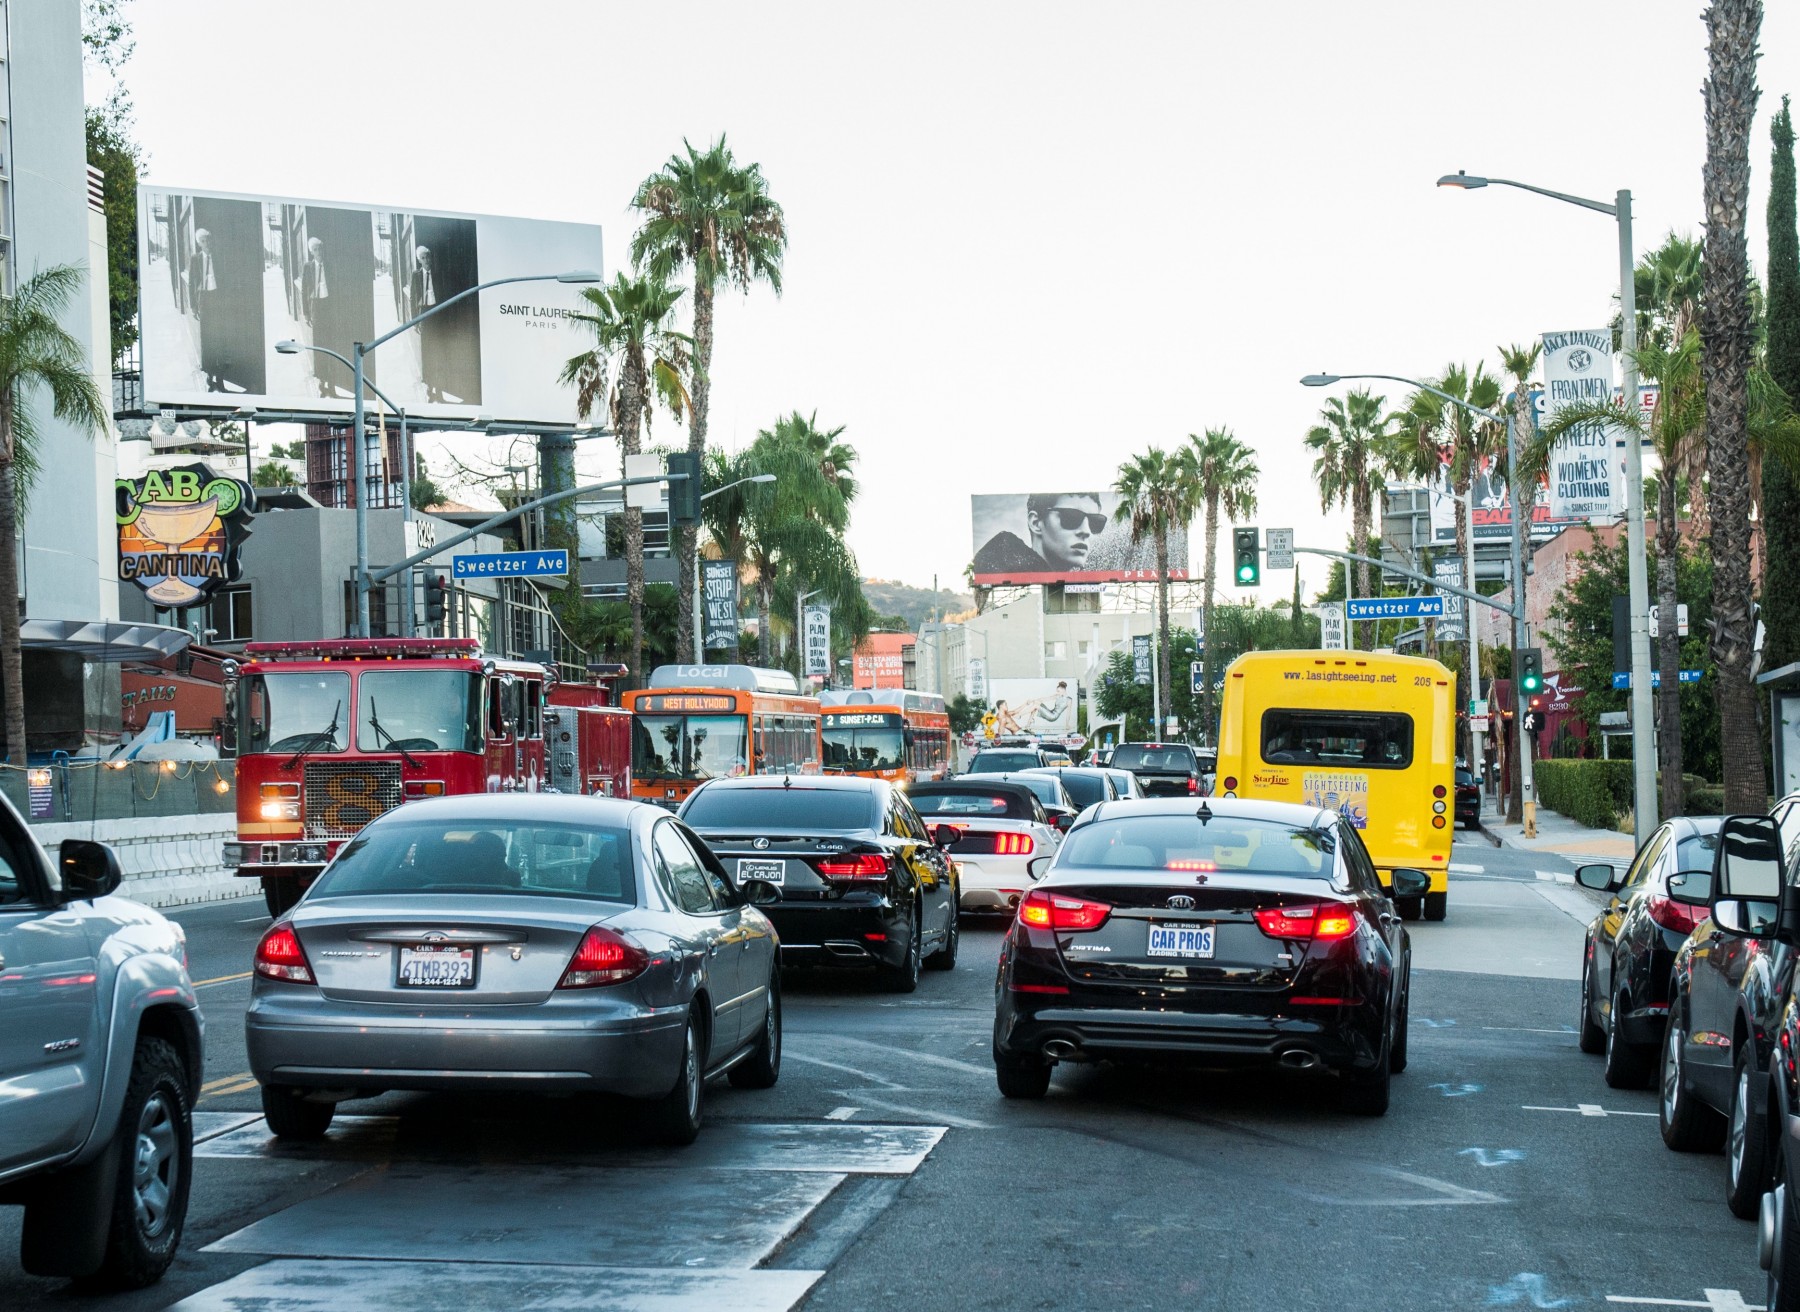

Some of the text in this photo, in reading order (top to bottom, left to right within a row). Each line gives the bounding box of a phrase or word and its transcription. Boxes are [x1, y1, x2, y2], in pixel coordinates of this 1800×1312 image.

[499, 304, 581, 319] SAINT LAURENT
[525, 321, 557, 330] PARIS
[1543, 332, 1569, 357] JACK
[1551, 378, 1608, 401] FRONTMEN
[162, 410, 175, 419] 243
[1557, 459, 1608, 482] WOMEN'S
[1557, 481, 1610, 499] CLOTHING
[1571, 502, 1593, 513] SUNSET
[1594, 502, 1608, 511] STRIP
[416, 520, 436, 549] 8295
[119, 554, 224, 582] CANTINA
[457, 557, 563, 573] Sweetzer Ave
[1435, 563, 1460, 575] SUNSET
[706, 567, 732, 578] SUNSET
[706, 579, 733, 600] STRIP
[709, 601, 733, 619] WEST
[1350, 603, 1410, 616] Sweetzer
[1418, 601, 1441, 613] Ave
[1443, 595, 1461, 614] EST
[809, 624, 826, 635] PLAY
[1325, 618, 1341, 629] PLAY
[809, 636, 826, 648] LOUD
[1325, 631, 1341, 640] LOUD
[809, 658, 827, 668] SLOW
[677, 666, 729, 678] Local
[1284, 671, 1432, 686] www.lasightseeing.net 205
[122, 685, 177, 708] TAILS
[644, 698, 729, 711] 2 WEST HOLLYWOOD
[827, 715, 834, 726] 2
[1303, 779, 1368, 793] SIGHTSEEING
[323, 773, 384, 829] 8
[741, 870, 781, 879] EL CAJON
[1171, 898, 1191, 909] KIA
[1151, 929, 1211, 951] CAR PROS
[402, 960, 470, 980] 6TMB393
[408, 978, 462, 986] 818-244-1234
